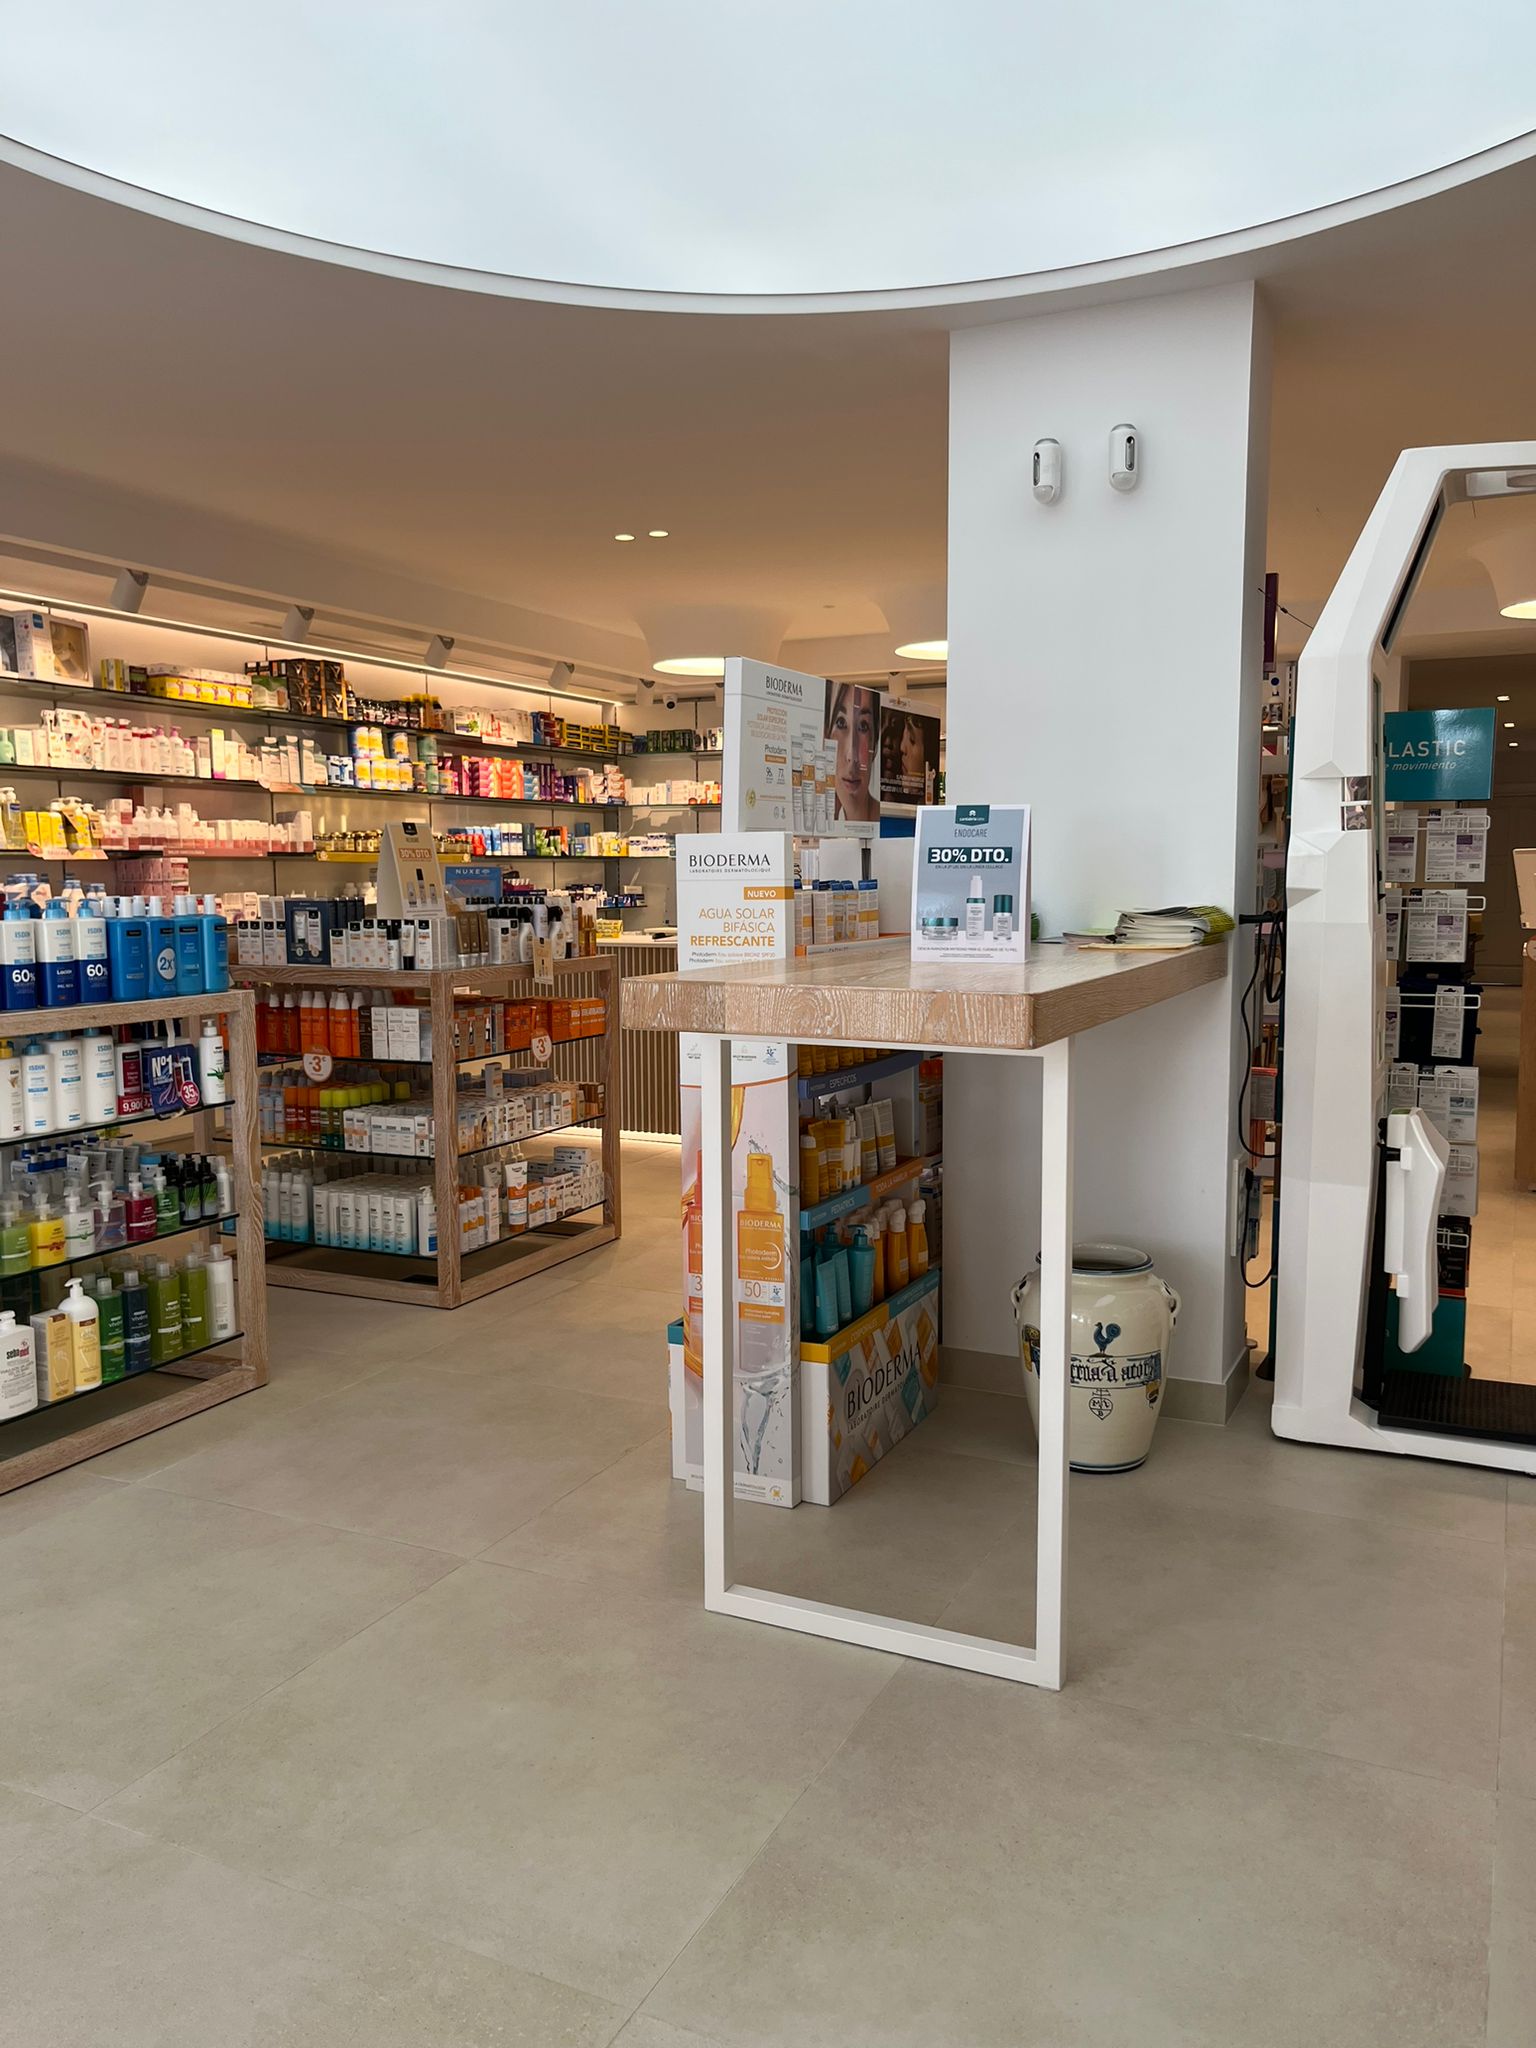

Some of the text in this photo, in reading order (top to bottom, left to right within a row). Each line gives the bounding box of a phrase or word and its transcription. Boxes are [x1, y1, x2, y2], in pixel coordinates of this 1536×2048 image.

[766, 675, 803, 696] BIODERMA
[1388, 739, 1466, 758] LASTIC
[1391, 761, 1457, 771] movimiento
[954, 828, 988, 838] ENDOCARE
[689, 853, 771, 867] BIODERMA
[930, 848, 1009, 862] 30% DTO.
[747, 889, 777, 898] NUEVO
[698, 907, 775, 919] AGUA SOLAR
[723, 919, 775, 933] BIFÁSICA
[690, 935, 775, 947] REFRESCANTE
[160, 957, 175, 971] 2x
[62, 1049, 79, 1057] ISDIN
[740, 1219, 782, 1229] BIODERMA
[694, 1275, 703, 1291] 3
[744, 1281, 761, 1297] 50
[846, 1342, 922, 1419] BIODERMA
